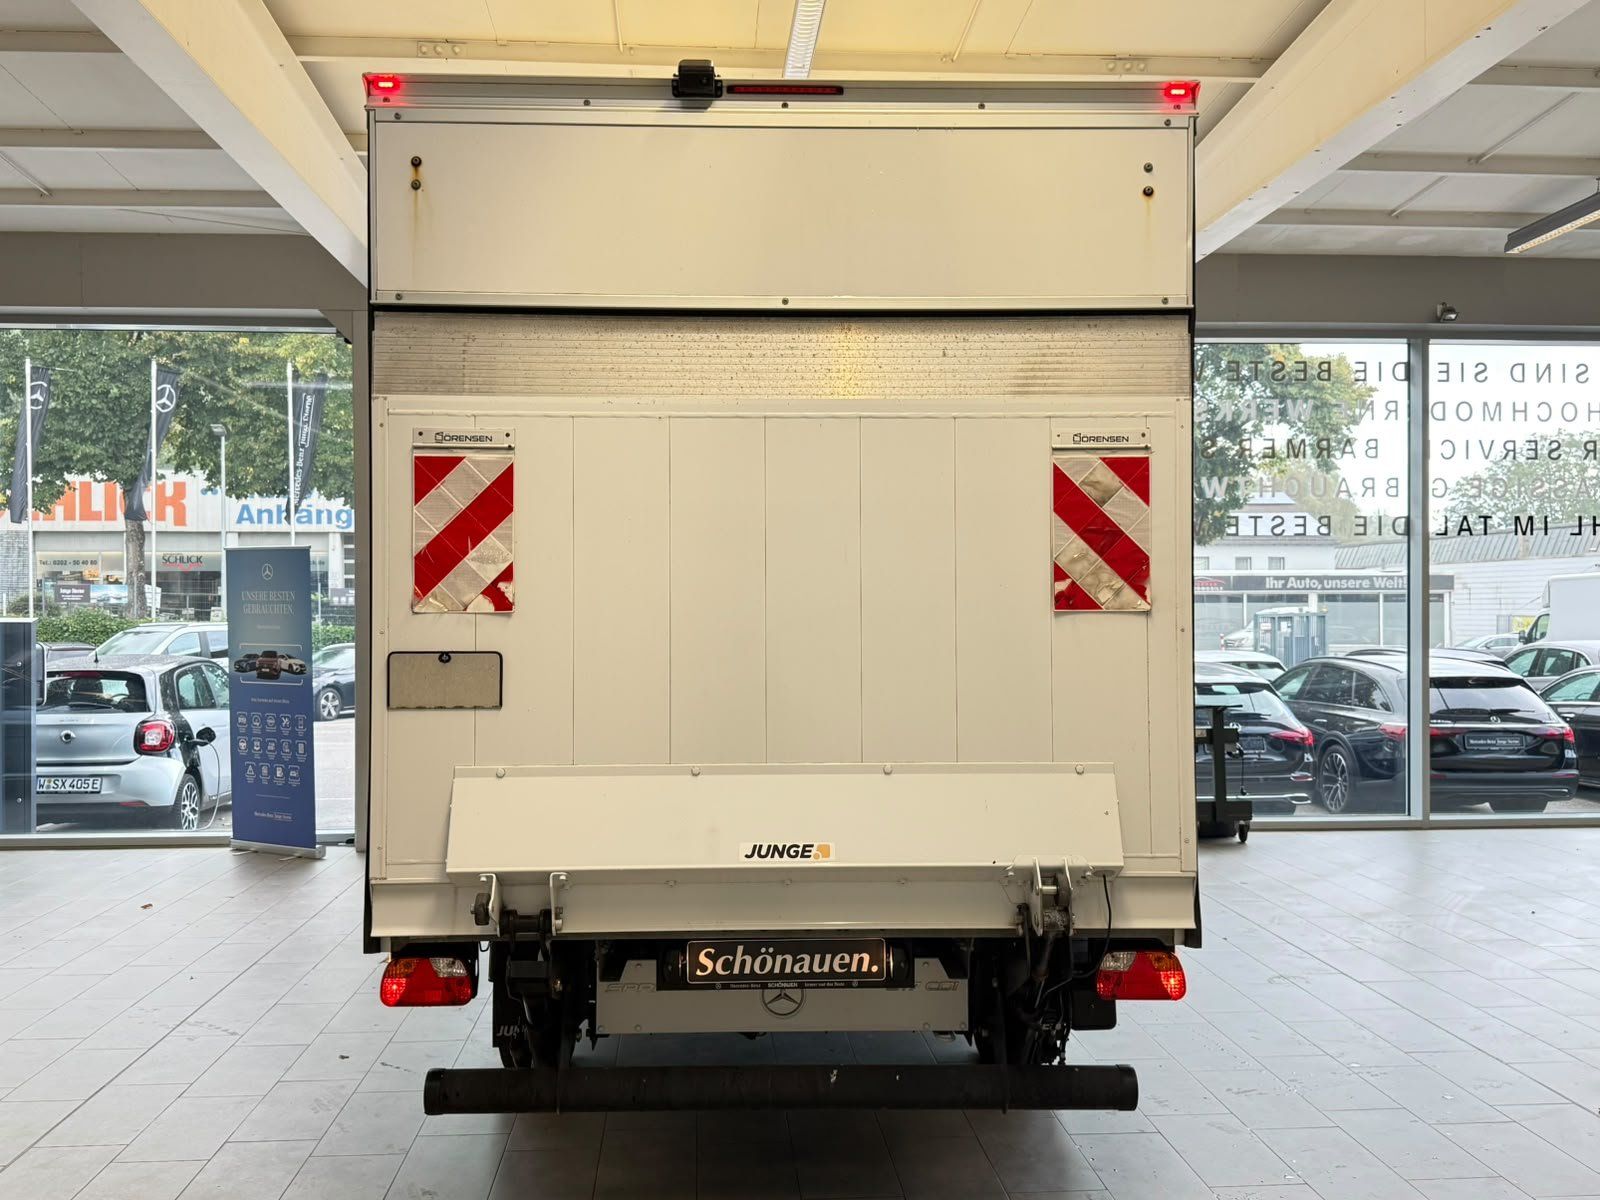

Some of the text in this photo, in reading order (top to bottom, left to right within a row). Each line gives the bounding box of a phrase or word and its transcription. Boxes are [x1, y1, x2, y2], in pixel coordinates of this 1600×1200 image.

[1265, 576, 1284, 588] Ihr
[1286, 576, 1321, 590] Auto,
[1323, 578, 1370, 589] unsere
[38, 779, 46, 789] W
[744, 843, 814, 859] JUNGE
[695, 945, 879, 976] Schönauen.
